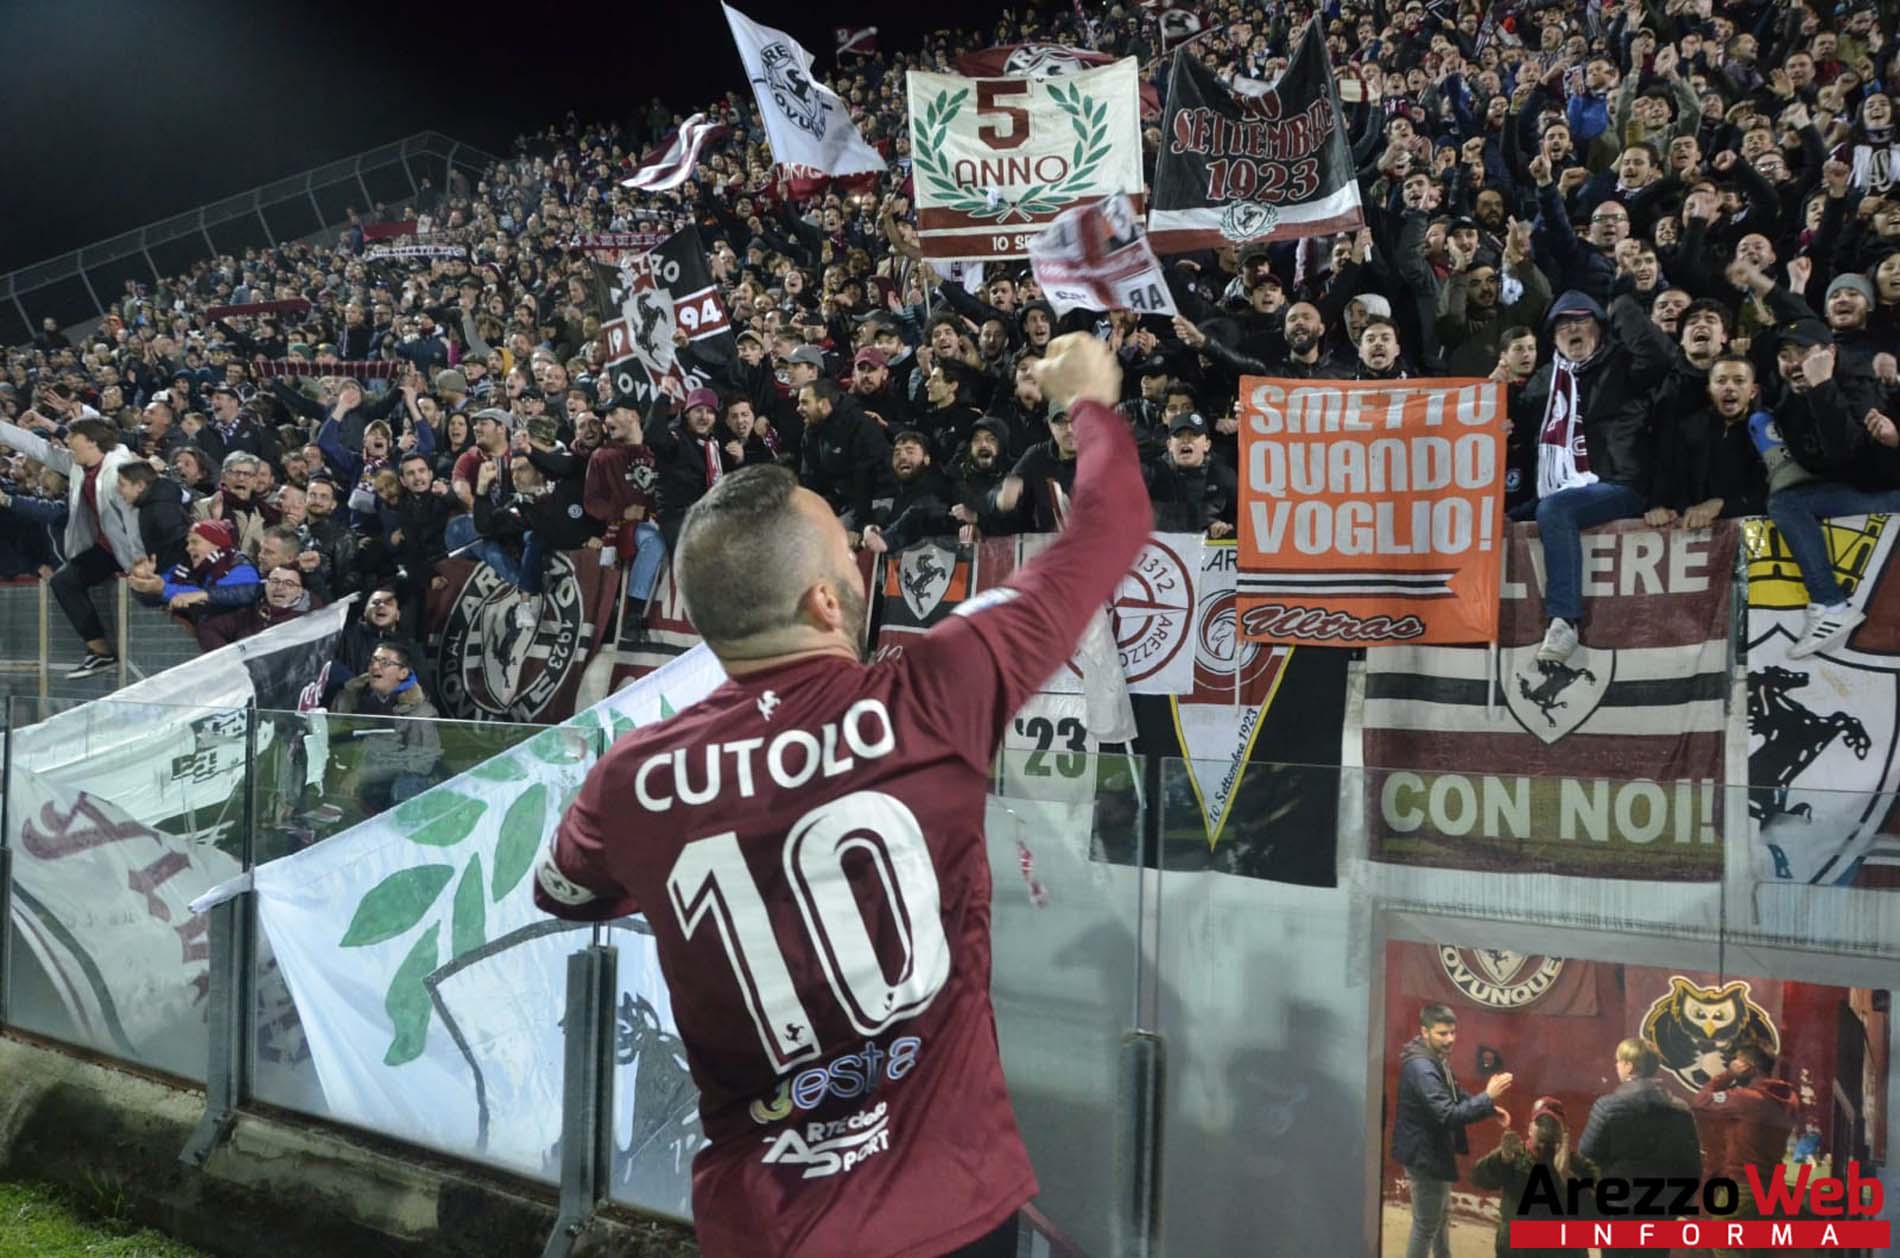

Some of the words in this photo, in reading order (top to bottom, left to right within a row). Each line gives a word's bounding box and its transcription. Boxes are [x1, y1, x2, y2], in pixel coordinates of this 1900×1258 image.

[976, 80, 1031, 150] 5
[1171, 97, 1337, 161] SETTEMBRE
[954, 155, 1069, 188] ANNO
[1206, 158, 1321, 203] 1923
[992, 237, 1009, 251] 10
[607, 328, 624, 357] 19
[679, 298, 724, 331] 94
[1250, 383, 1498, 434] SMETTO
[1250, 433, 1497, 498] QUANDO
[1250, 497, 1495, 555] VOGLIO!
[1137, 553, 1175, 594] 1312
[548, 619, 573, 670] 1923
[1242, 604, 1426, 642] Ultras
[635, 699, 895, 812] CUTOLO
[1209, 805, 1221, 823] 10
[1238, 707, 1258, 741] 1923
[1381, 771, 1532, 838] CON
[1560, 775, 1717, 845] NOI!
[666, 791, 950, 1075] 10
[1442, 946, 1562, 1005] OVUNQUE
